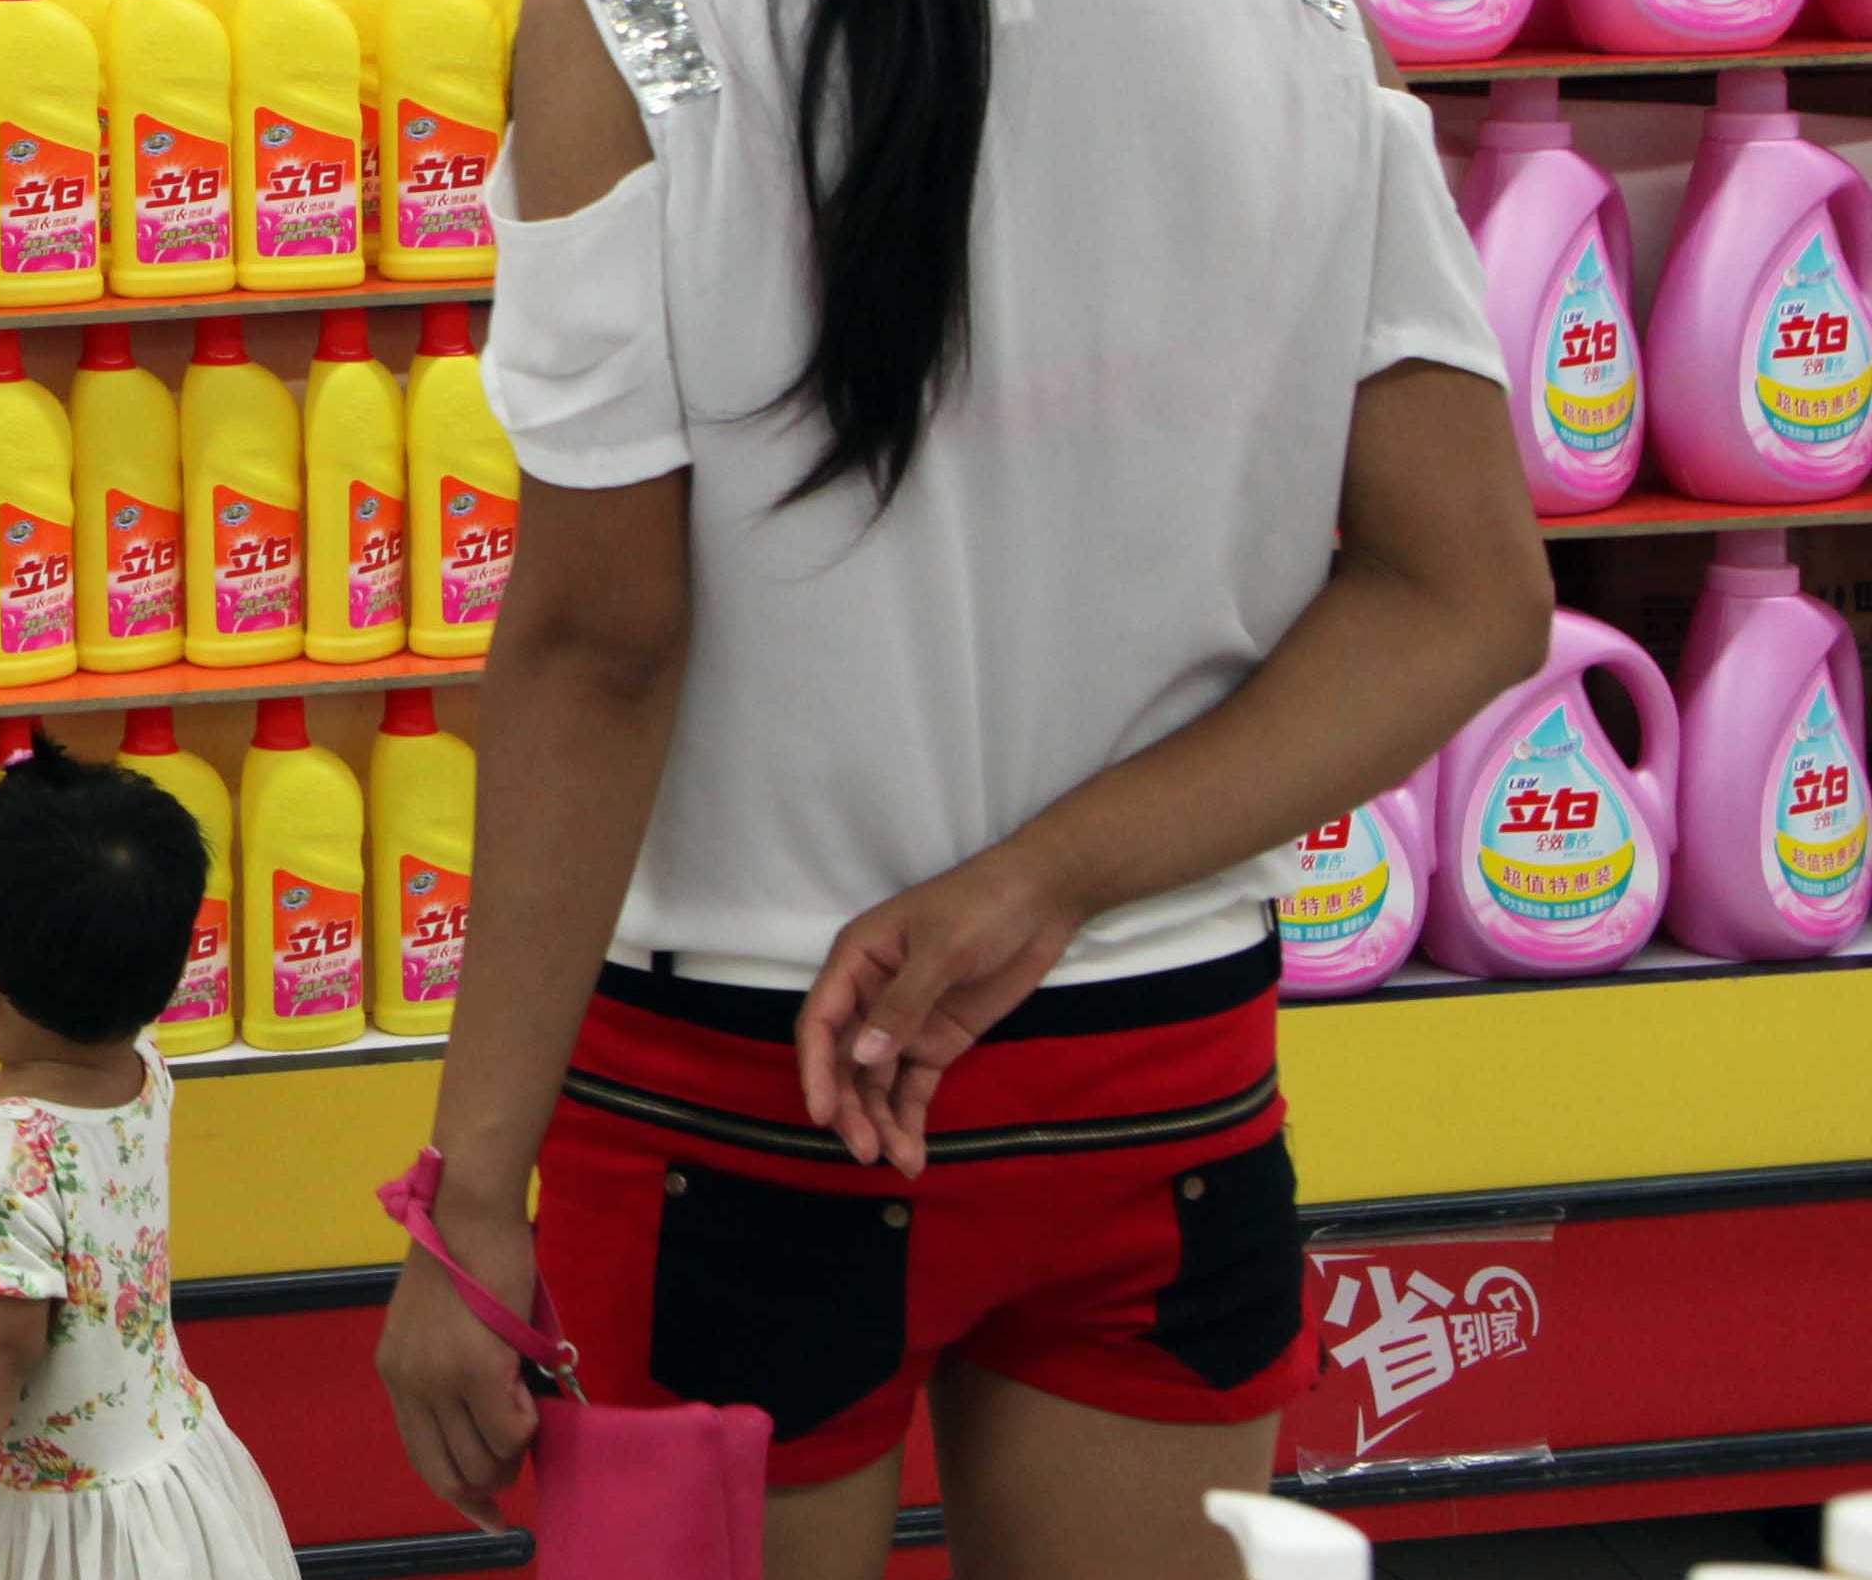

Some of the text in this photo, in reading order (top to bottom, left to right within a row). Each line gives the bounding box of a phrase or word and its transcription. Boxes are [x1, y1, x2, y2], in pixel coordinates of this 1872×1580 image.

[10, 177, 85, 217] 立白
[267, 162, 343, 201] 立白
[1559, 322, 1617, 367] 立白
[1774, 313, 1848, 359] 立白
[226, 536, 292, 578] 立白
[1499, 788, 1598, 833] 立白
